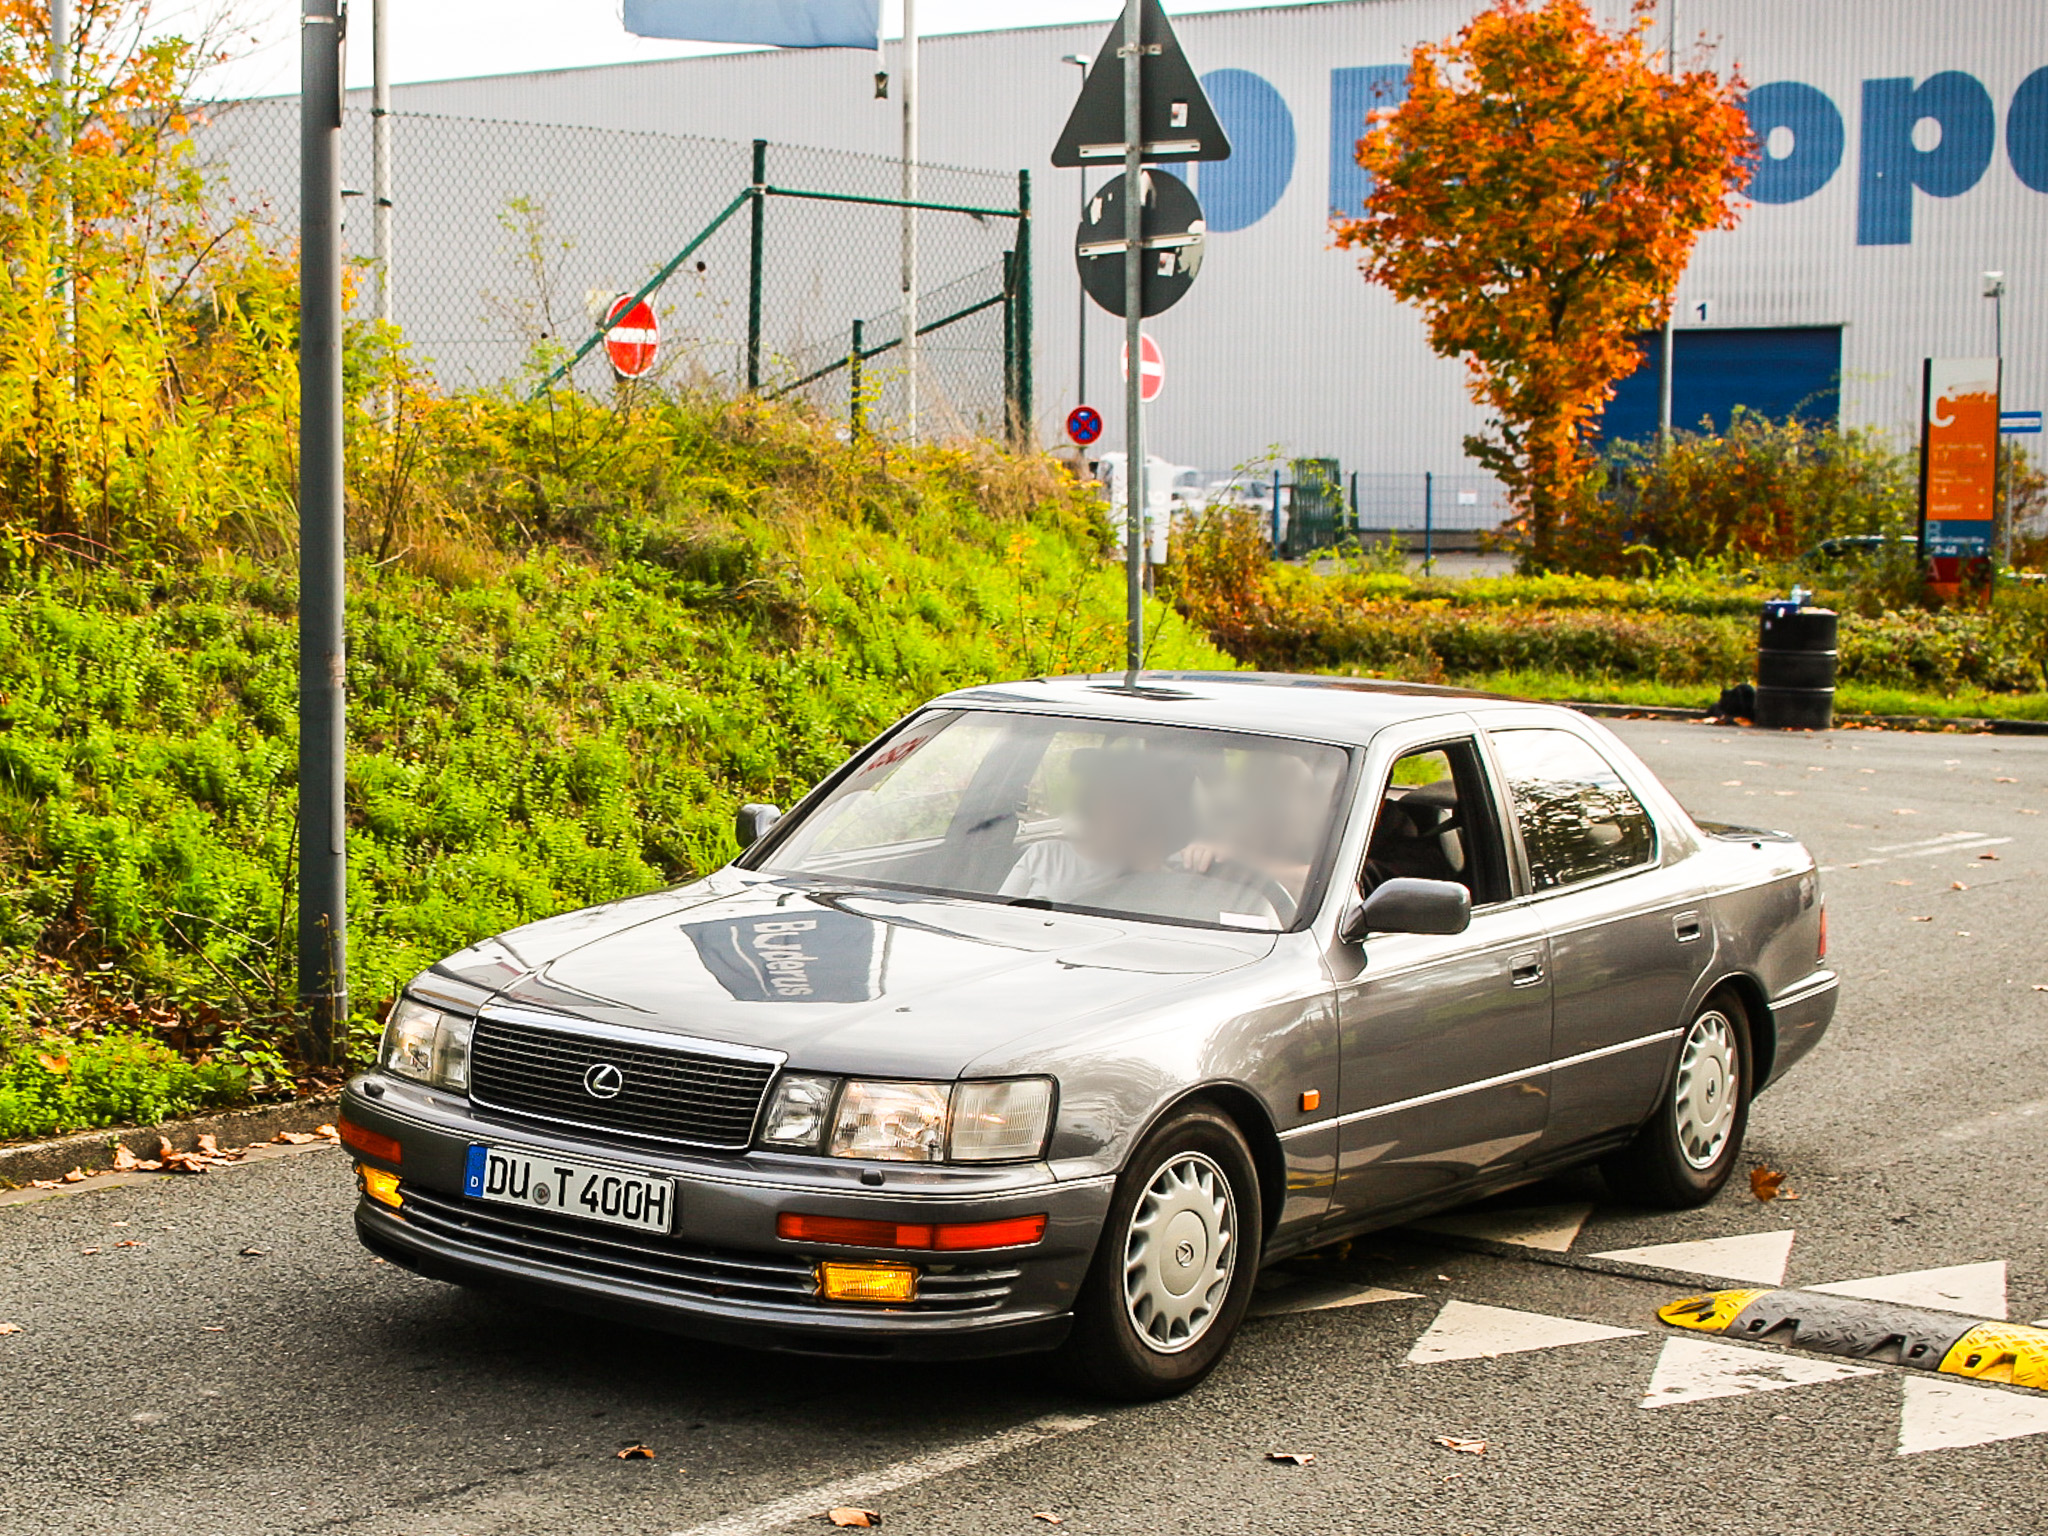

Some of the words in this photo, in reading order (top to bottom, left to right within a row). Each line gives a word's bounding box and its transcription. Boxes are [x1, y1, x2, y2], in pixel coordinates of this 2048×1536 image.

[1696, 302, 1707, 322] 1
[752, 919, 818, 996] Buderus
[470, 1176, 479, 1188] D
[486, 1155, 531, 1200] DU
[553, 1167, 574, 1207] T
[580, 1174, 666, 1226] 400H
